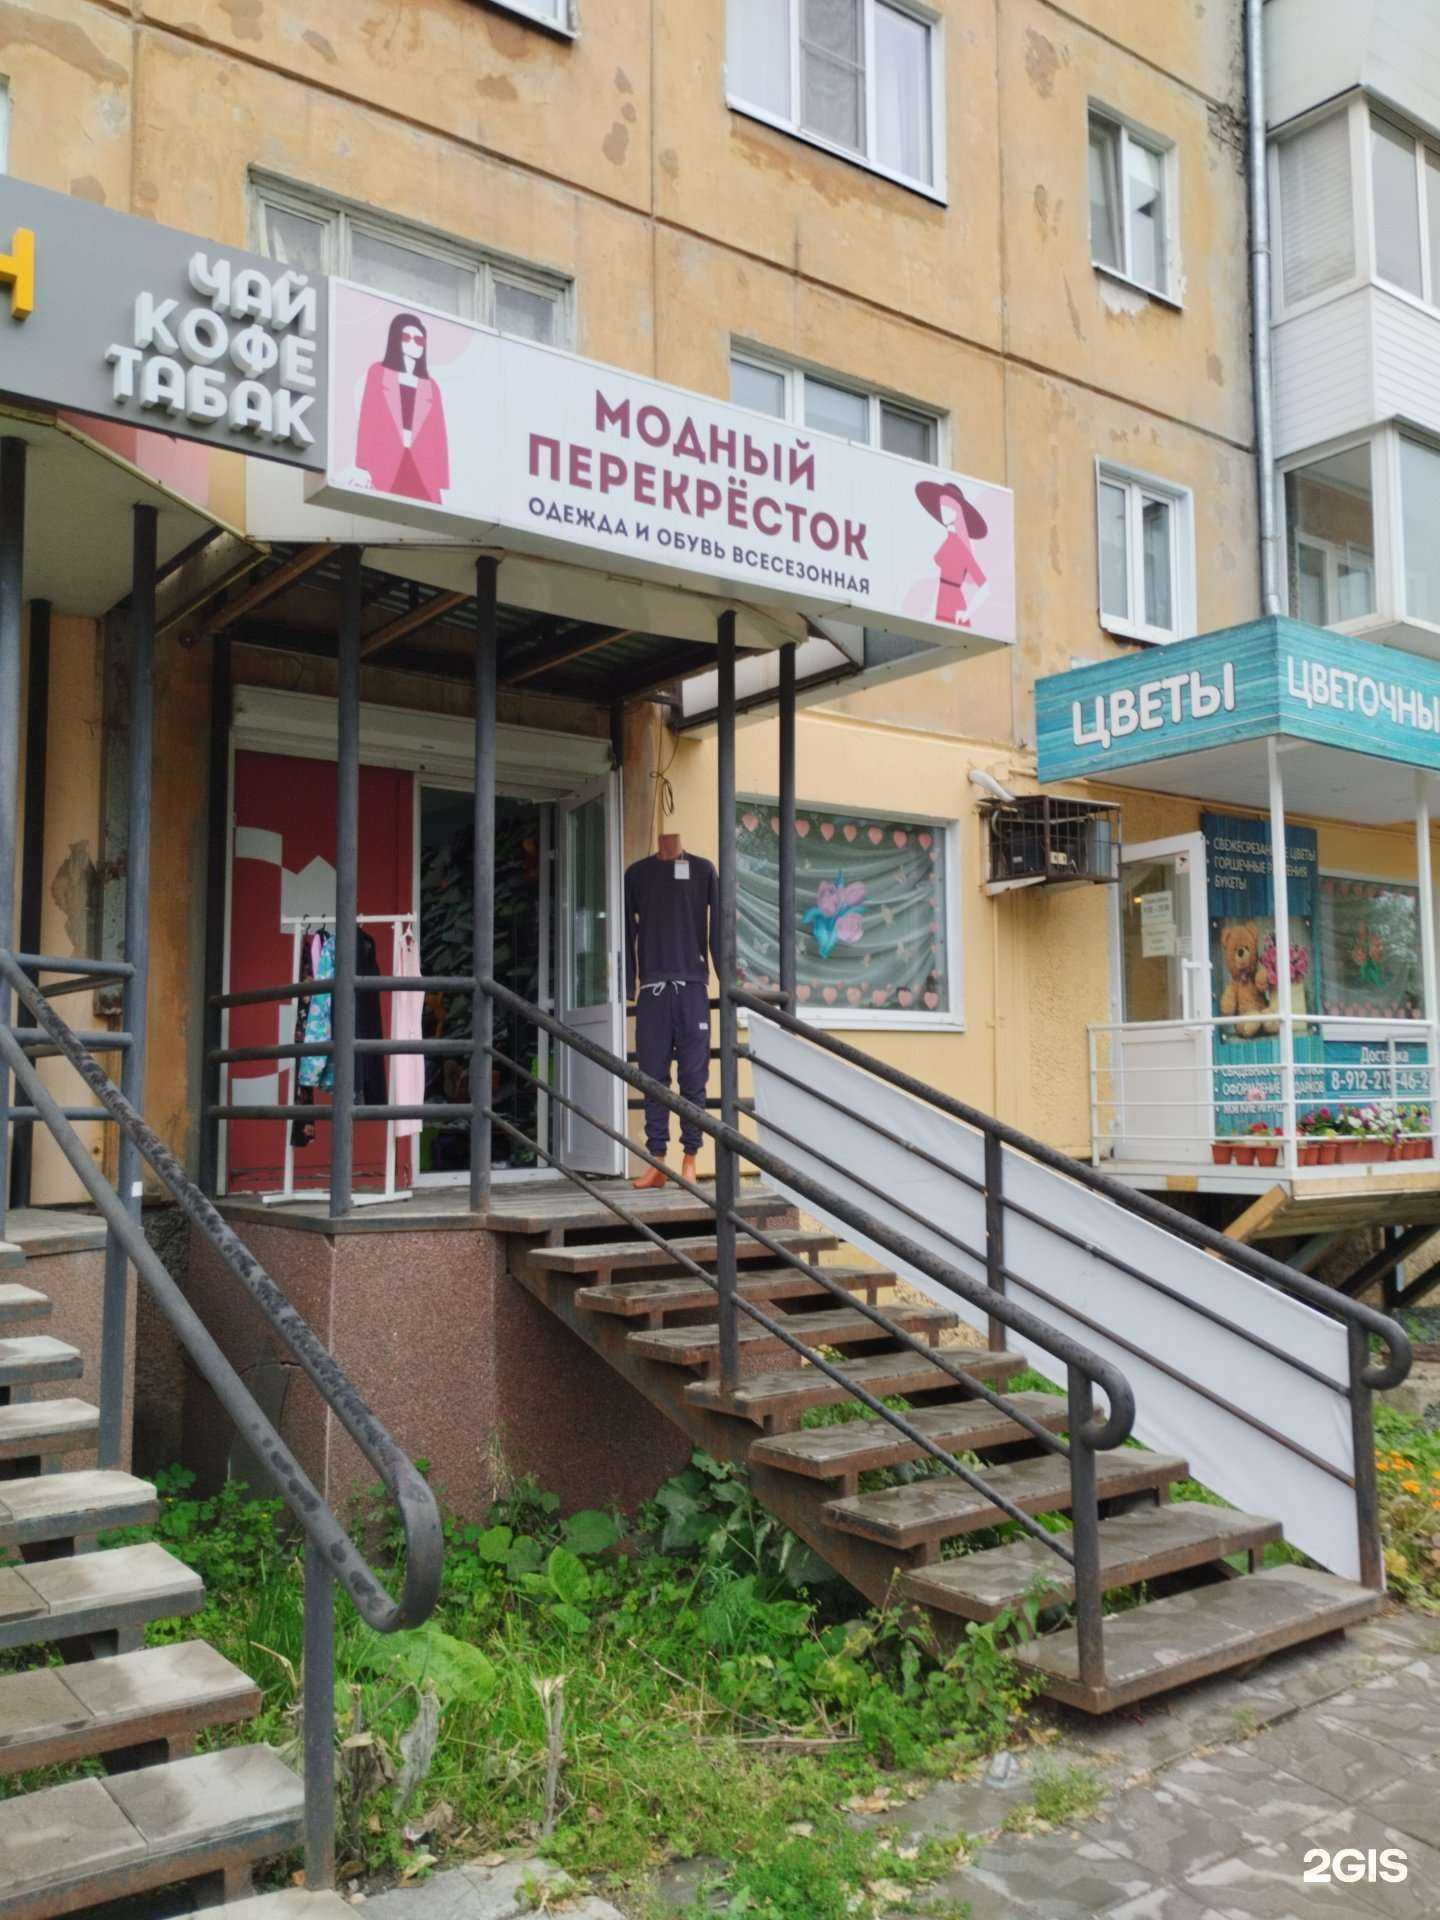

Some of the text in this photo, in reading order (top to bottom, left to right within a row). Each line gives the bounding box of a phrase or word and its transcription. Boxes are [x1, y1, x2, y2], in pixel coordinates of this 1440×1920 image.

[134, 290, 317, 392] КОФЕ
[188, 251, 317, 337] ЧАЙ
[104, 343, 316, 448] ТАБАК
[595, 389, 815, 492] МОДНЫЙ
[528, 432, 869, 561] ПЕРЕКРЁСТОК
[528, 496, 870, 594] ОДЕЖДА И ОБУВЬ ВСЕСЕЗОННАЯ
[1072, 661, 1235, 749] ЦВЕТЫ
[1215, 874, 1247, 890] БУКЕТЫ
[1361, 1046, 1409, 1064] Достака
